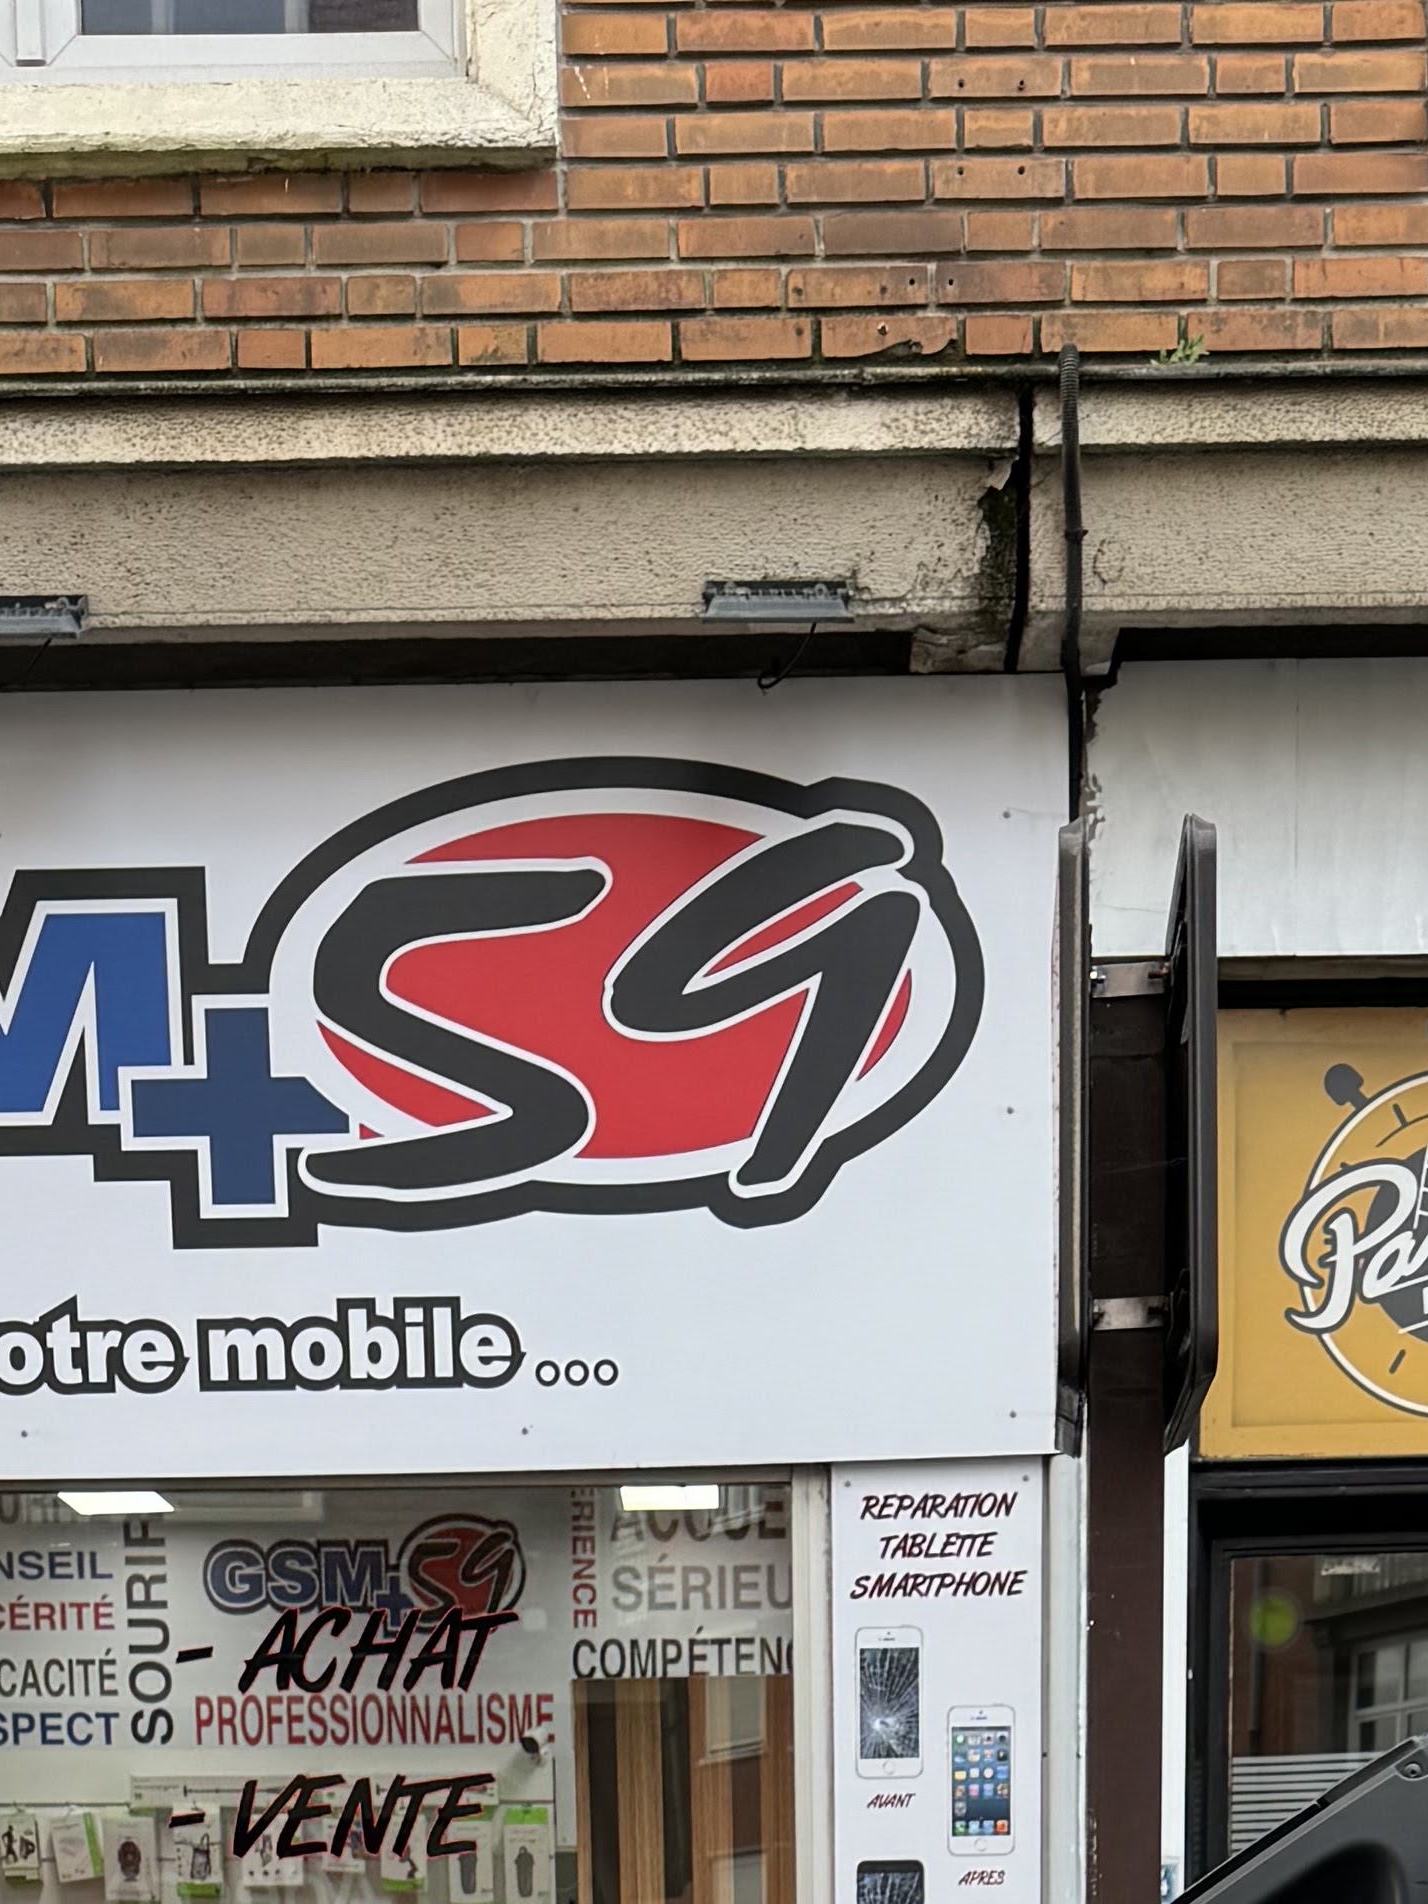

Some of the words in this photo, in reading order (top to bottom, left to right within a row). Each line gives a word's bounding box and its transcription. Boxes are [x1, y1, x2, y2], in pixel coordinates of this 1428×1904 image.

[860, 1493, 1016, 1521] REPARATION
[878, 1531, 994, 1559] TABLETTE
[849, 1569, 1027, 1601] SMARTPHONE
[238, 1607, 519, 1696] ACHAT
[573, 1626, 793, 1679] COMPÉTEN
[231, 1772, 496, 1860] VENTE
[867, 1792, 916, 1810] AVANT
[959, 1869, 1005, 1888] APRES
